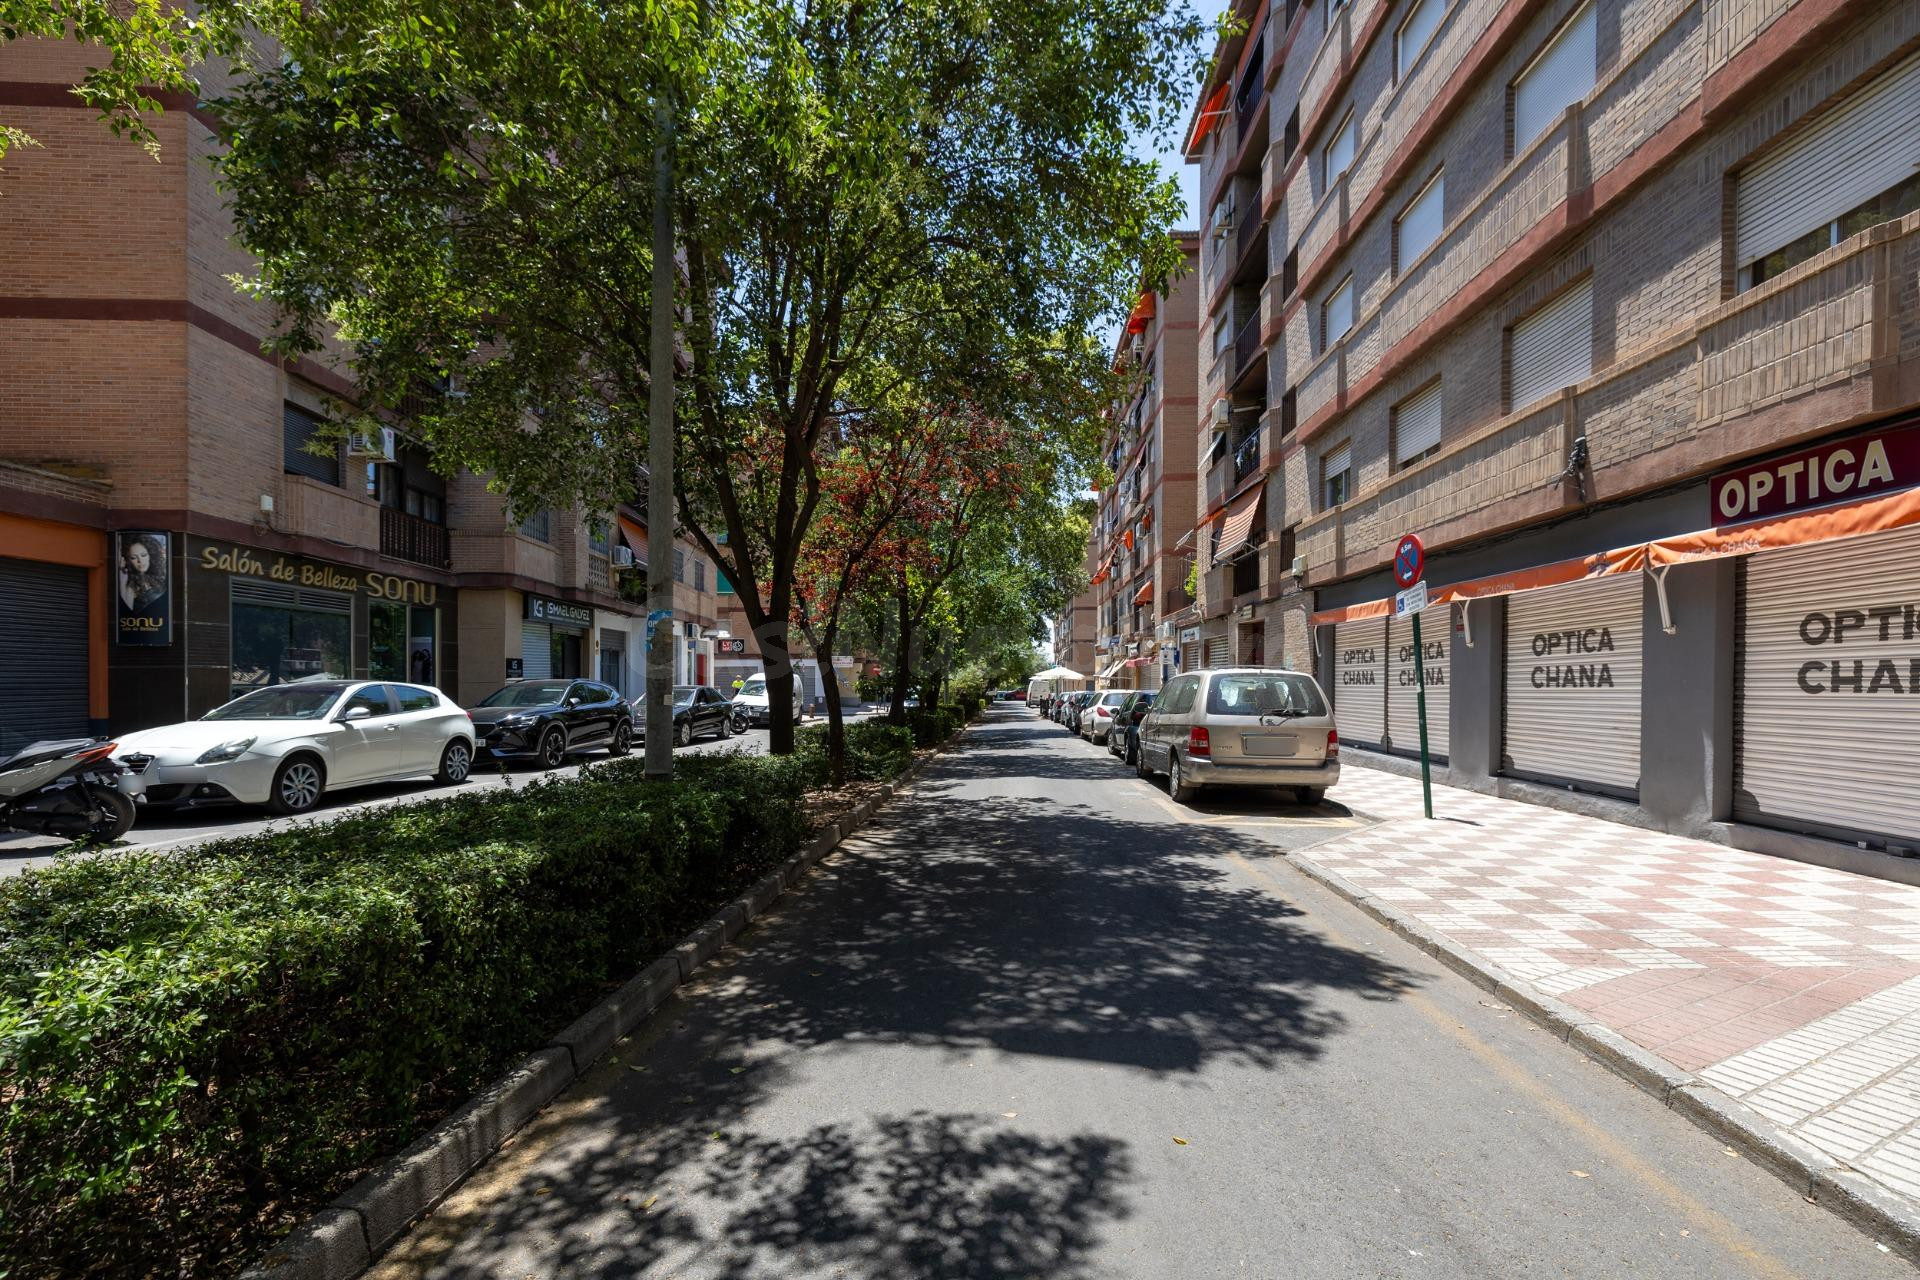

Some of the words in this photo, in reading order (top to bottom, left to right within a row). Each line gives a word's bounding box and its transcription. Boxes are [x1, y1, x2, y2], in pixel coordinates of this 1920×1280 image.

[1719, 439, 1895, 518] OPTICA
[1720, 539, 1761, 554] CHANA
[202, 547, 265, 576] Salón
[270, 557, 295, 581] de
[300, 565, 358, 592] Belleza
[1799, 604, 1920, 645] OPTI
[1399, 641, 1444, 662] OPICA
[1532, 627, 1615, 656] OPTICA
[1343, 648, 1375, 664] OPTICA
[1343, 670, 1375, 685] CHANA
[1399, 667, 1444, 686] CHNA
[1531, 663, 1615, 689] CHANA
